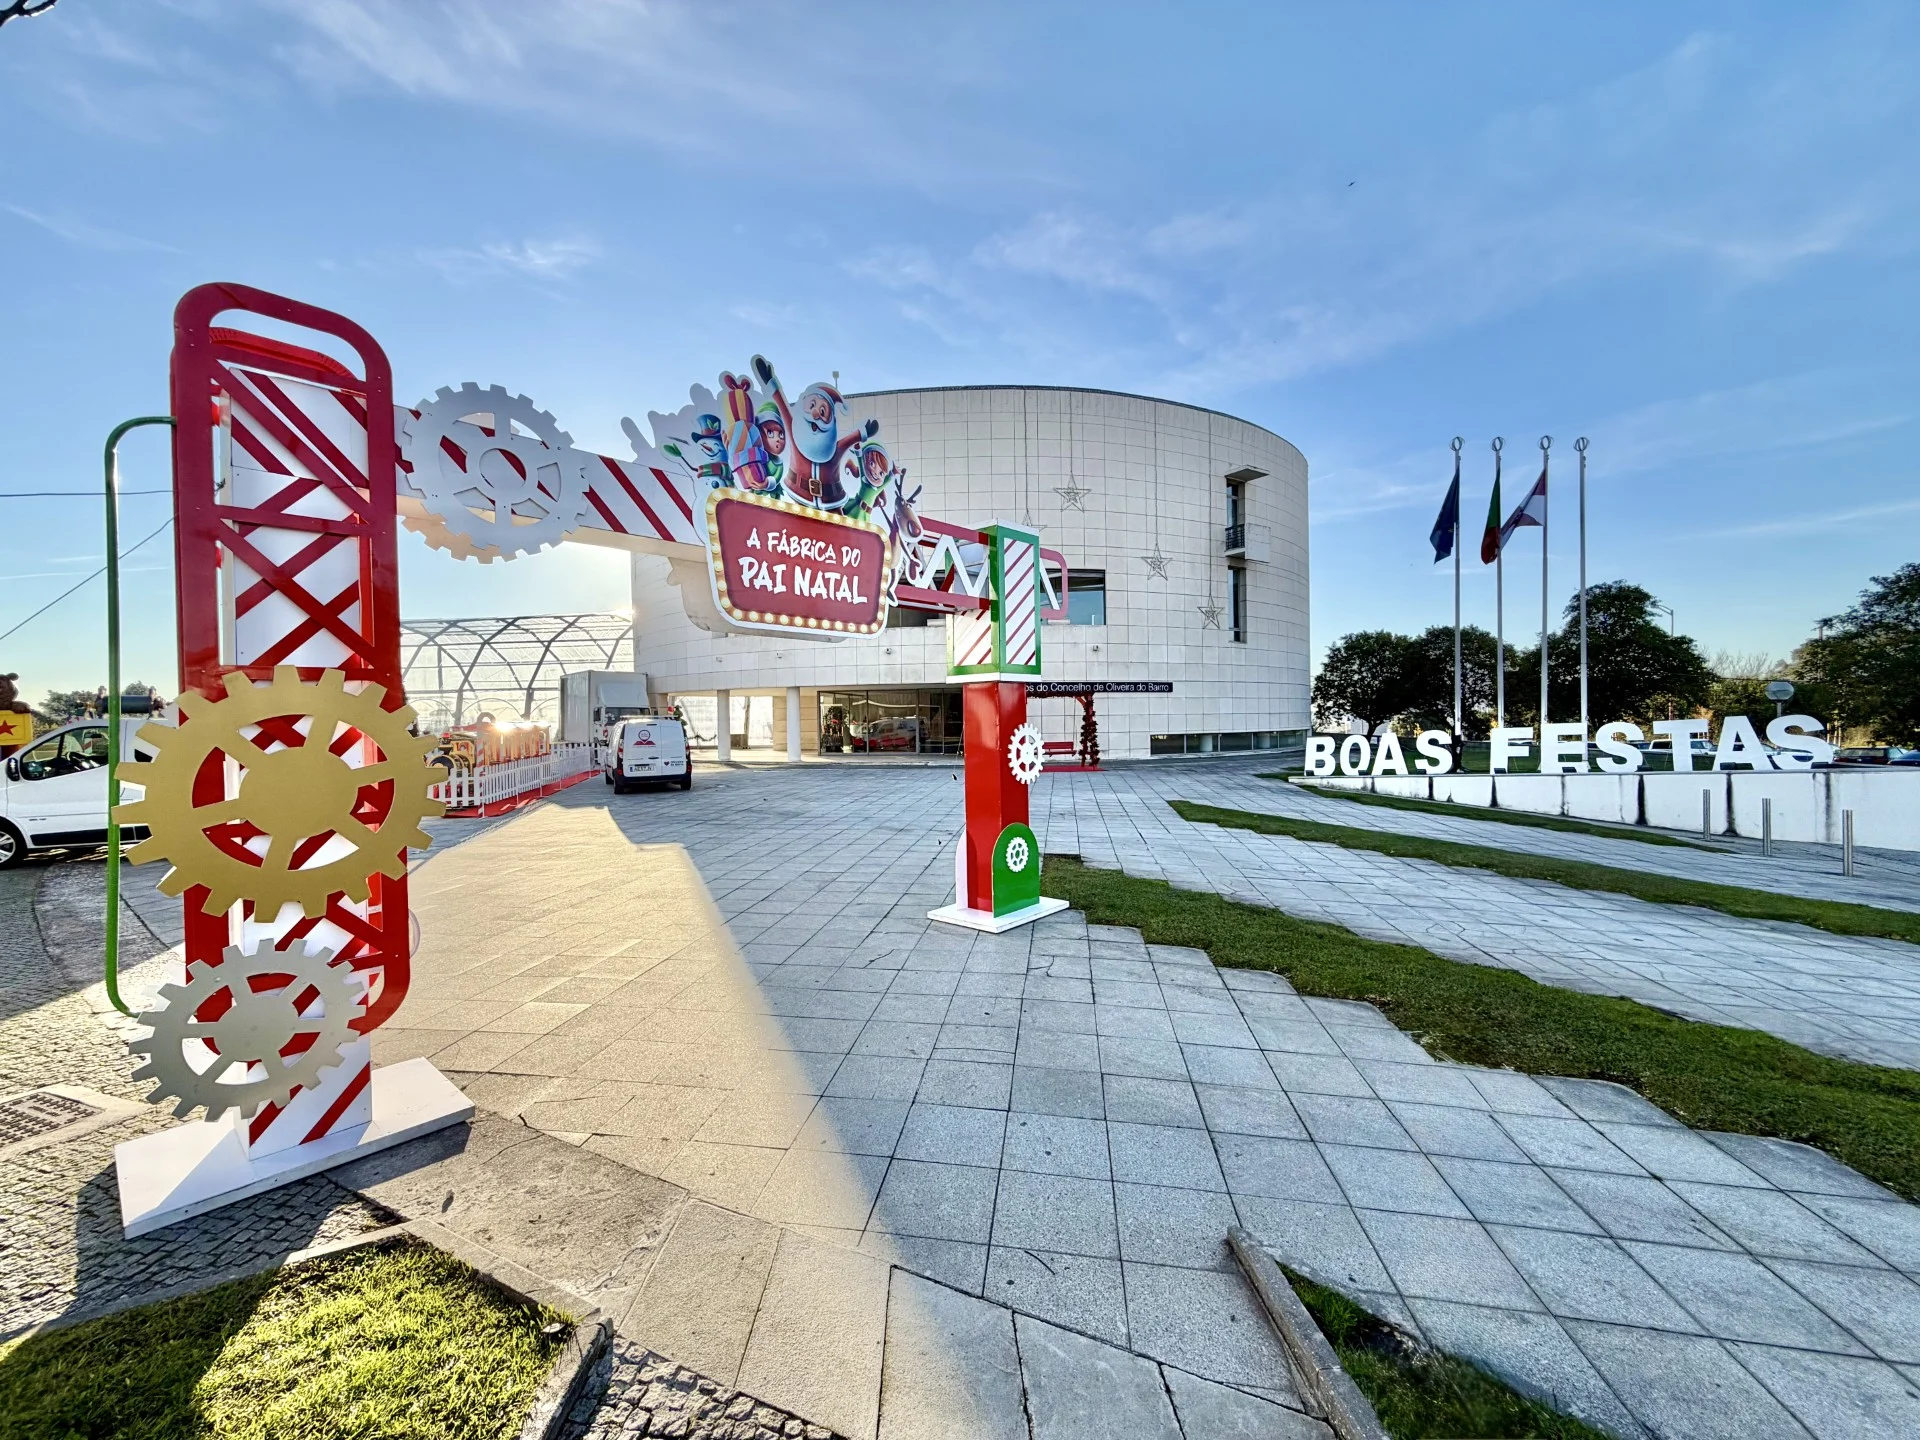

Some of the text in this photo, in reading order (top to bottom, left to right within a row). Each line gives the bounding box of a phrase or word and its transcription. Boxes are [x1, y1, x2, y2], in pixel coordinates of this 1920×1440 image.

[747, 527, 761, 549] A
[841, 546, 861, 568] DO
[738, 556, 868, 605] PAI NATAL
[1036, 683, 1049, 692] do
[1050, 682, 1091, 692] Concelho
[1093, 682, 1104, 692] de
[1106, 682, 1135, 692] Oliveira
[1136, 682, 1147, 692] do
[1148, 682, 1169, 692] Bairro
[1304, 714, 1834, 776] BOAS FESTAS
